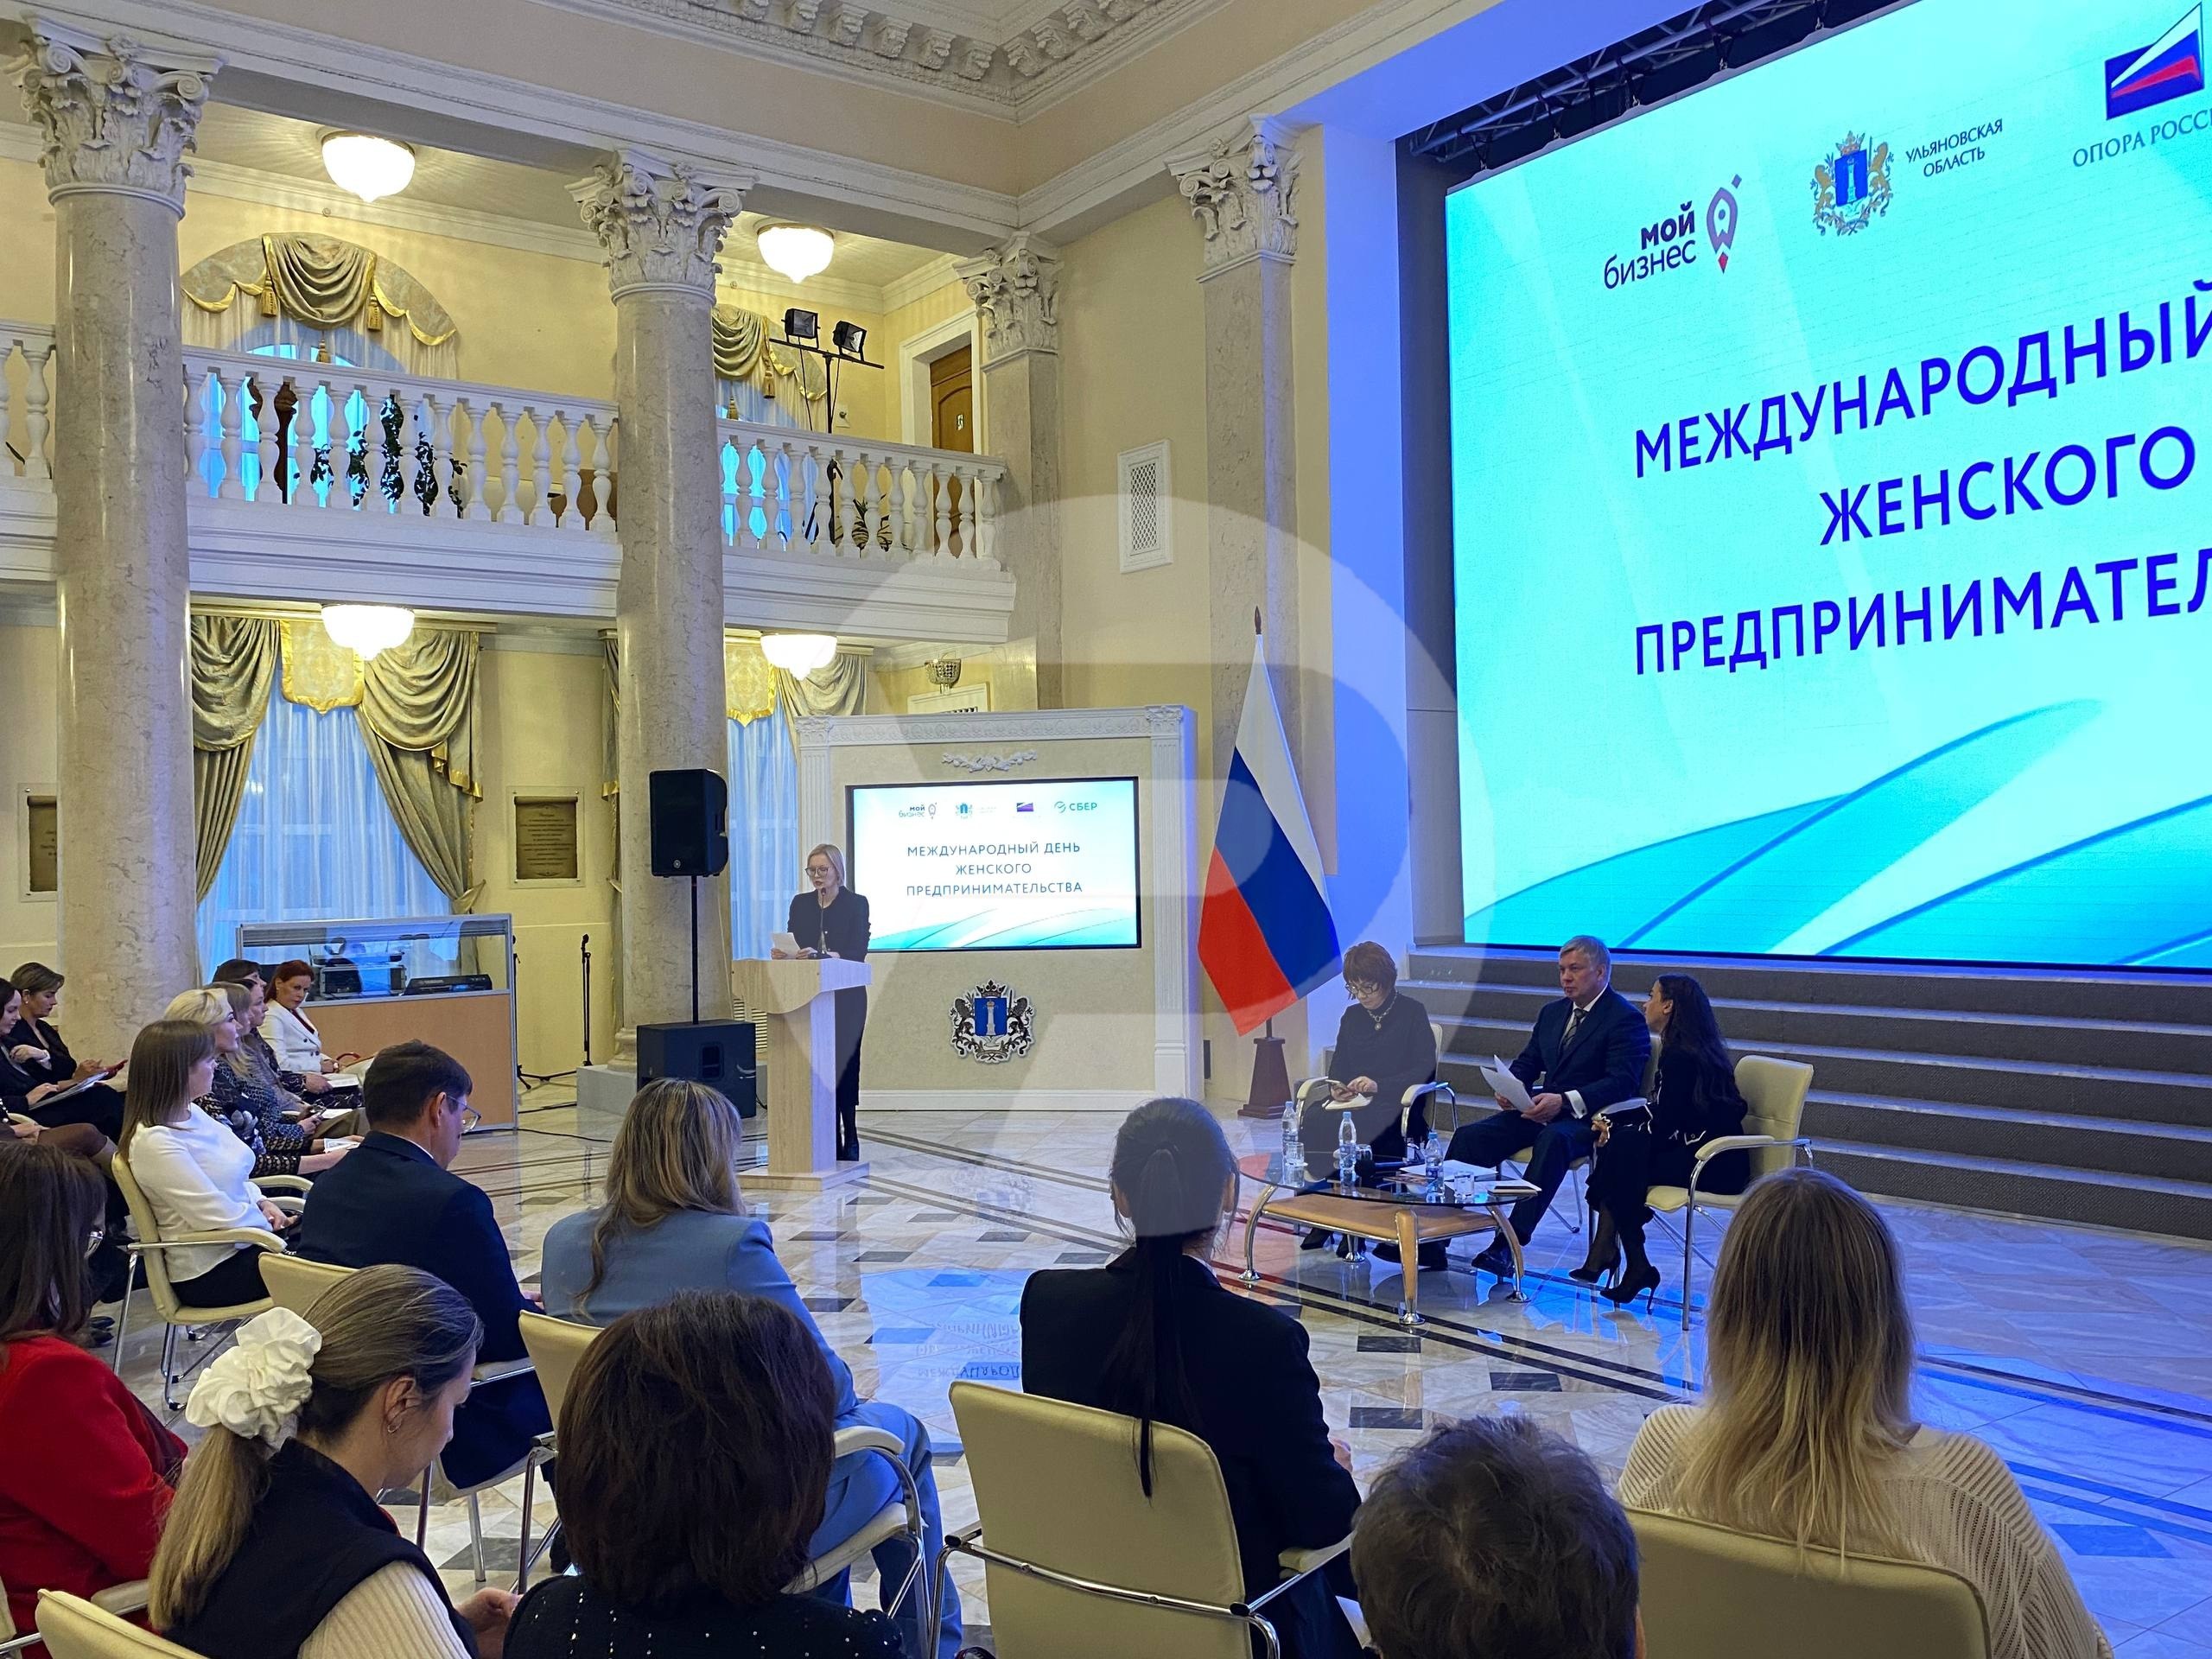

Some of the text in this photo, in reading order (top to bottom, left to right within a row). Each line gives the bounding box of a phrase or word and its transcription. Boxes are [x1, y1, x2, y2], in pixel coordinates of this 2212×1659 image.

[1905, 118, 2003, 163] УЛЬЯНОВСКАЯ
[2073, 107, 2212, 167] ОПОРА РОСС
[1923, 146, 1986, 177] ОБЛАСТЬ
[1641, 200, 1695, 251] мой
[1604, 239, 1696, 289] бизнес
[1636, 279, 2212, 478] МЕЖДУНАРОДНЫЙ
[1819, 426, 2196, 545] ЖЕНСКОГО
[1069, 802, 1097, 811] СБЕР
[907, 842, 1080, 857] МЕЖДУНАРОДНЫЙ ДЕНЬ
[956, 863, 1032, 875] ЖЕНСКОГО
[906, 882, 1083, 897] ПРЕДПРИНИМАТЕЛЬСТВА
